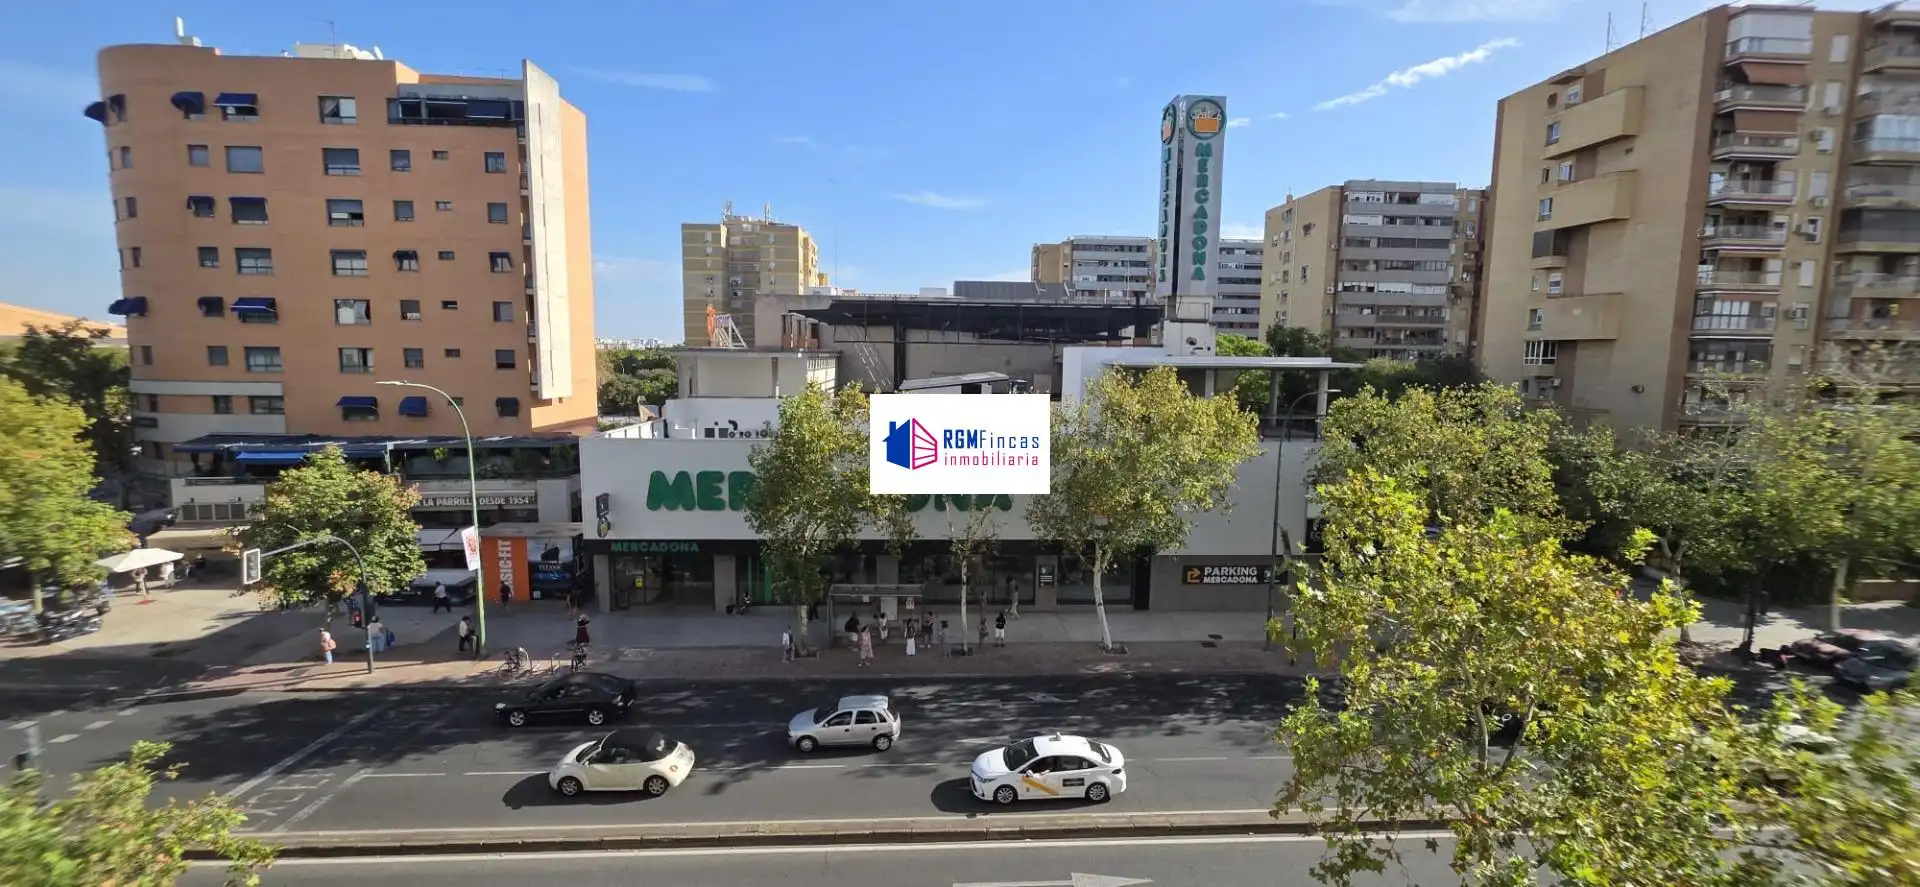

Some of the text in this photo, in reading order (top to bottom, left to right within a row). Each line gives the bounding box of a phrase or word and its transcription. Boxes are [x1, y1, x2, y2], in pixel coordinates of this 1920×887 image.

[1191, 142, 1213, 281] MERCADONA
[423, 498, 434, 507] LA
[436, 497, 476, 507] PARRILL
[479, 496, 506, 505] DESDE
[610, 541, 700, 552] MERCADONA
[497, 540, 514, 599] SIC-FIT
[1204, 566, 1258, 576] PARKING
[1203, 576, 1258, 584] MERCADONA
